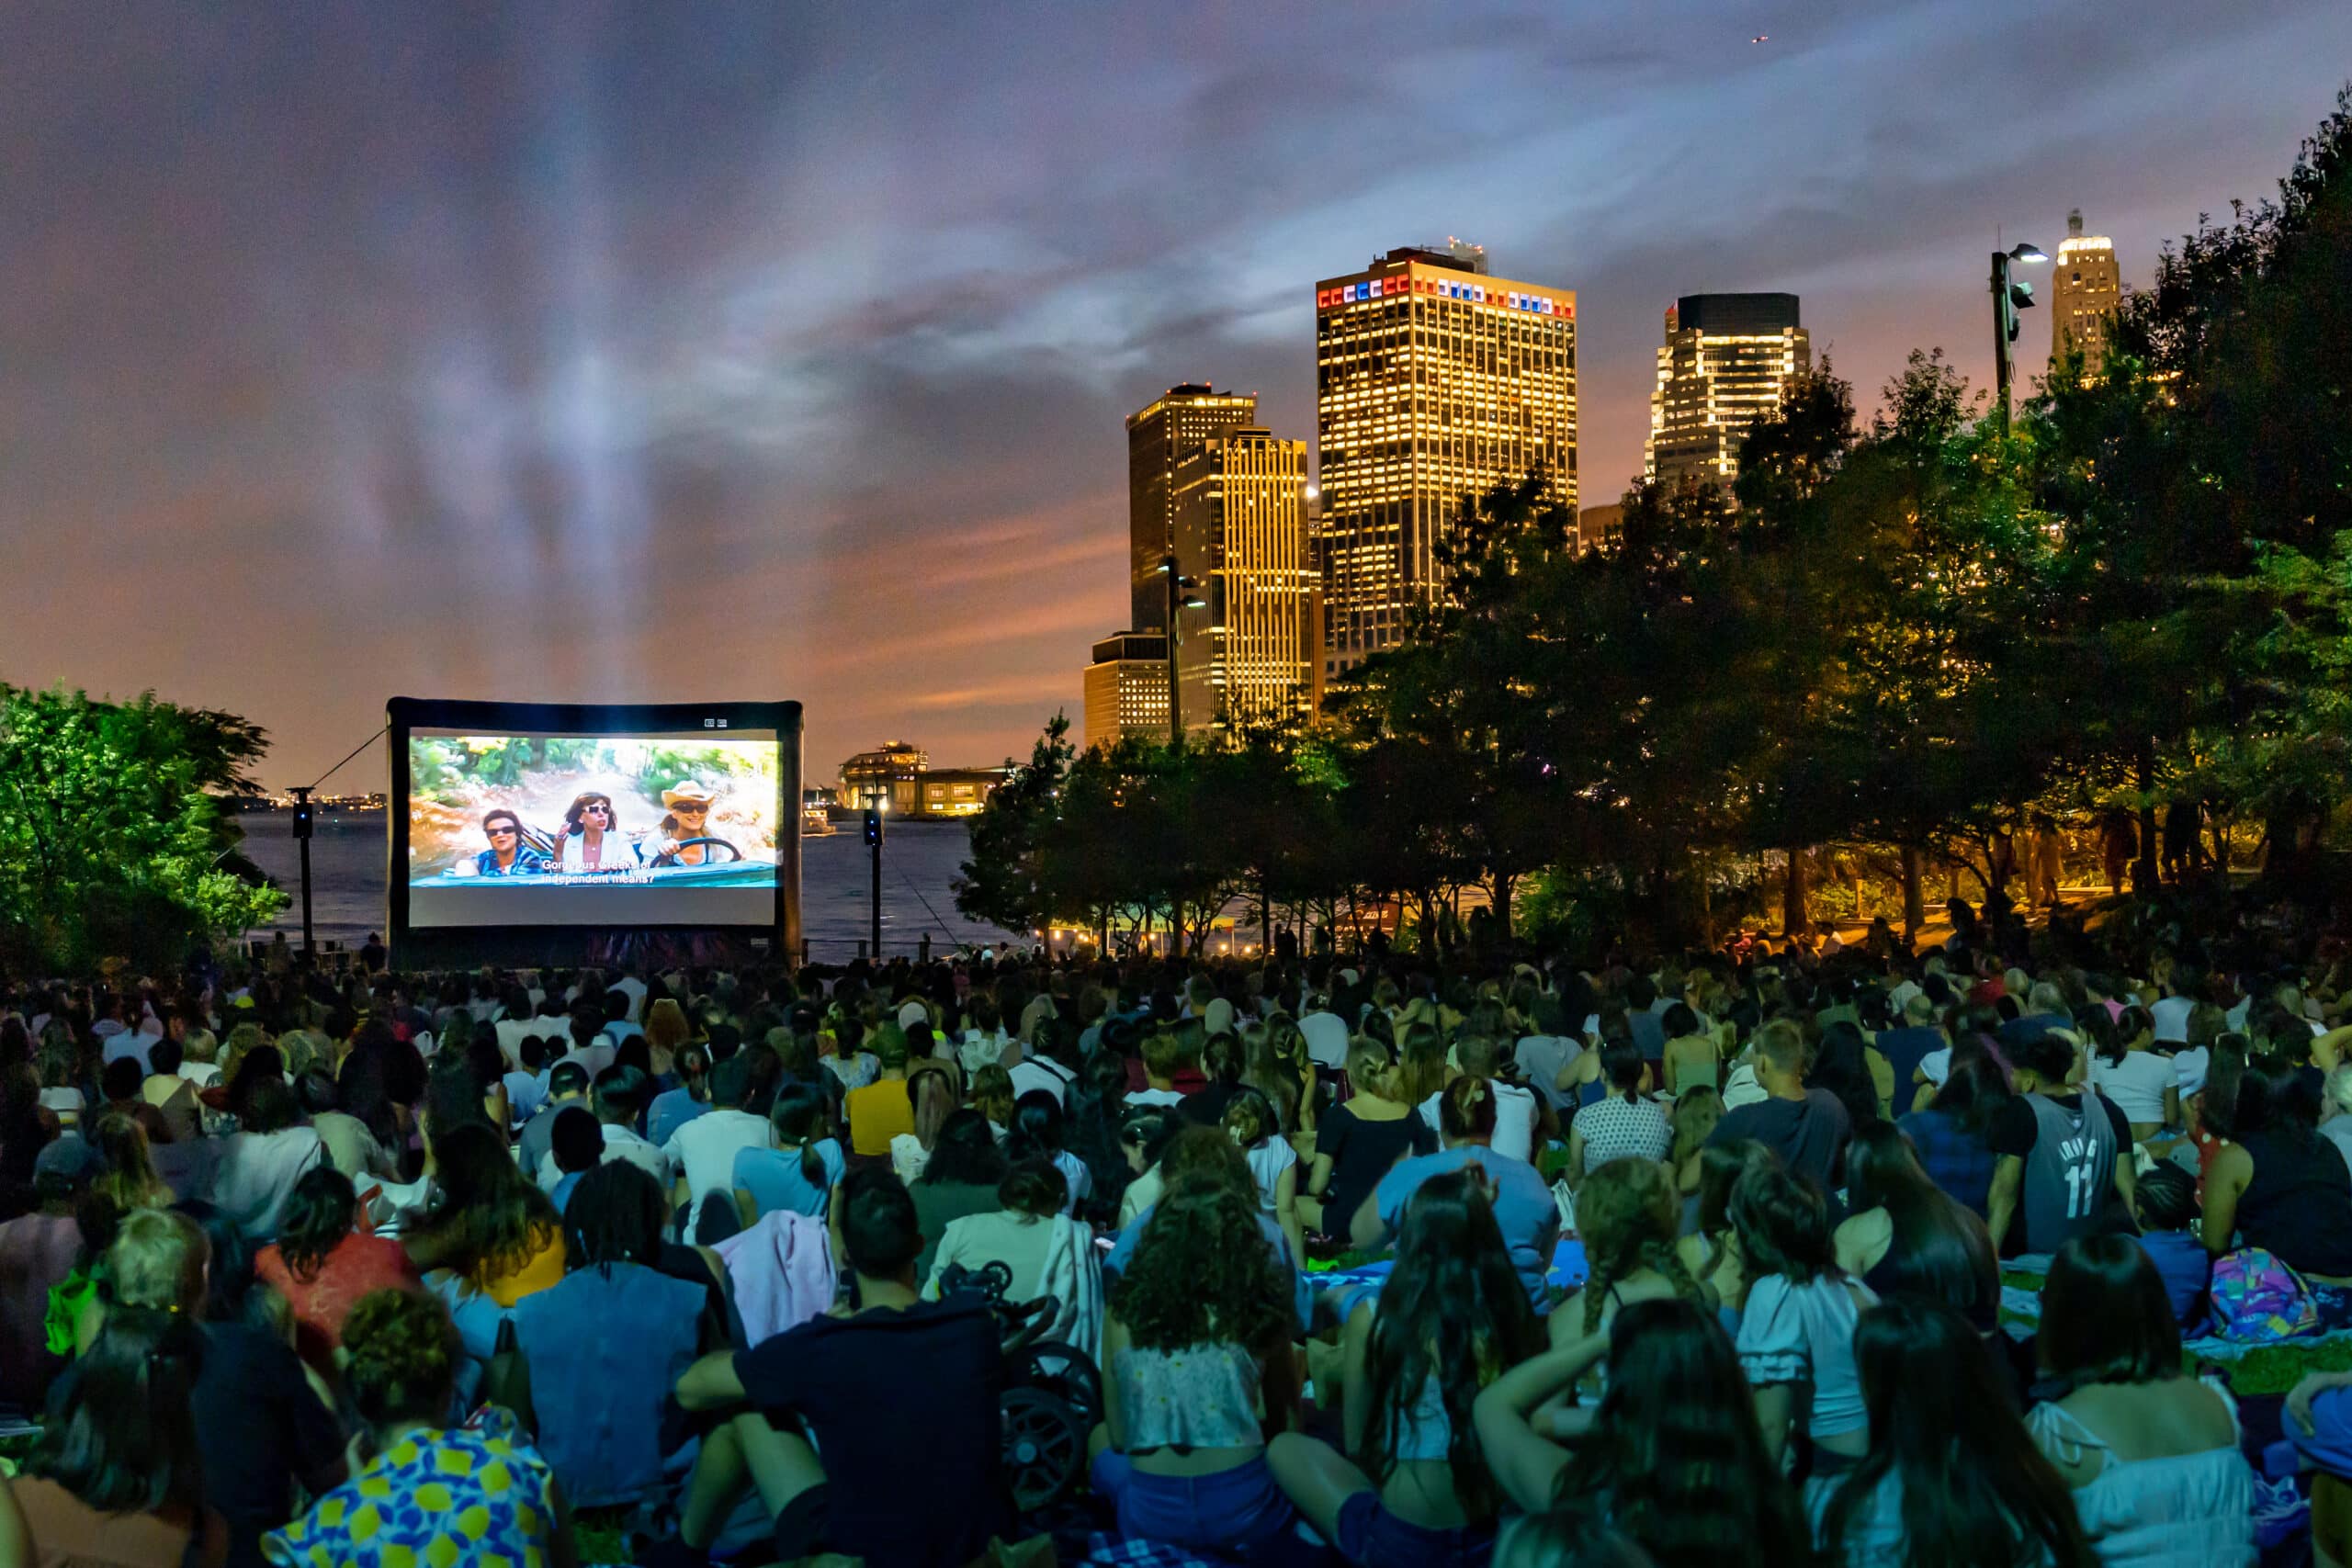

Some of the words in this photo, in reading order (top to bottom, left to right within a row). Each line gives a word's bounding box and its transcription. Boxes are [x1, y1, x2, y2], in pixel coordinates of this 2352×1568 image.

[542, 874, 609, 885] independent
[612, 874, 654, 884] means?
[2064, 1163, 2093, 1219] 11
